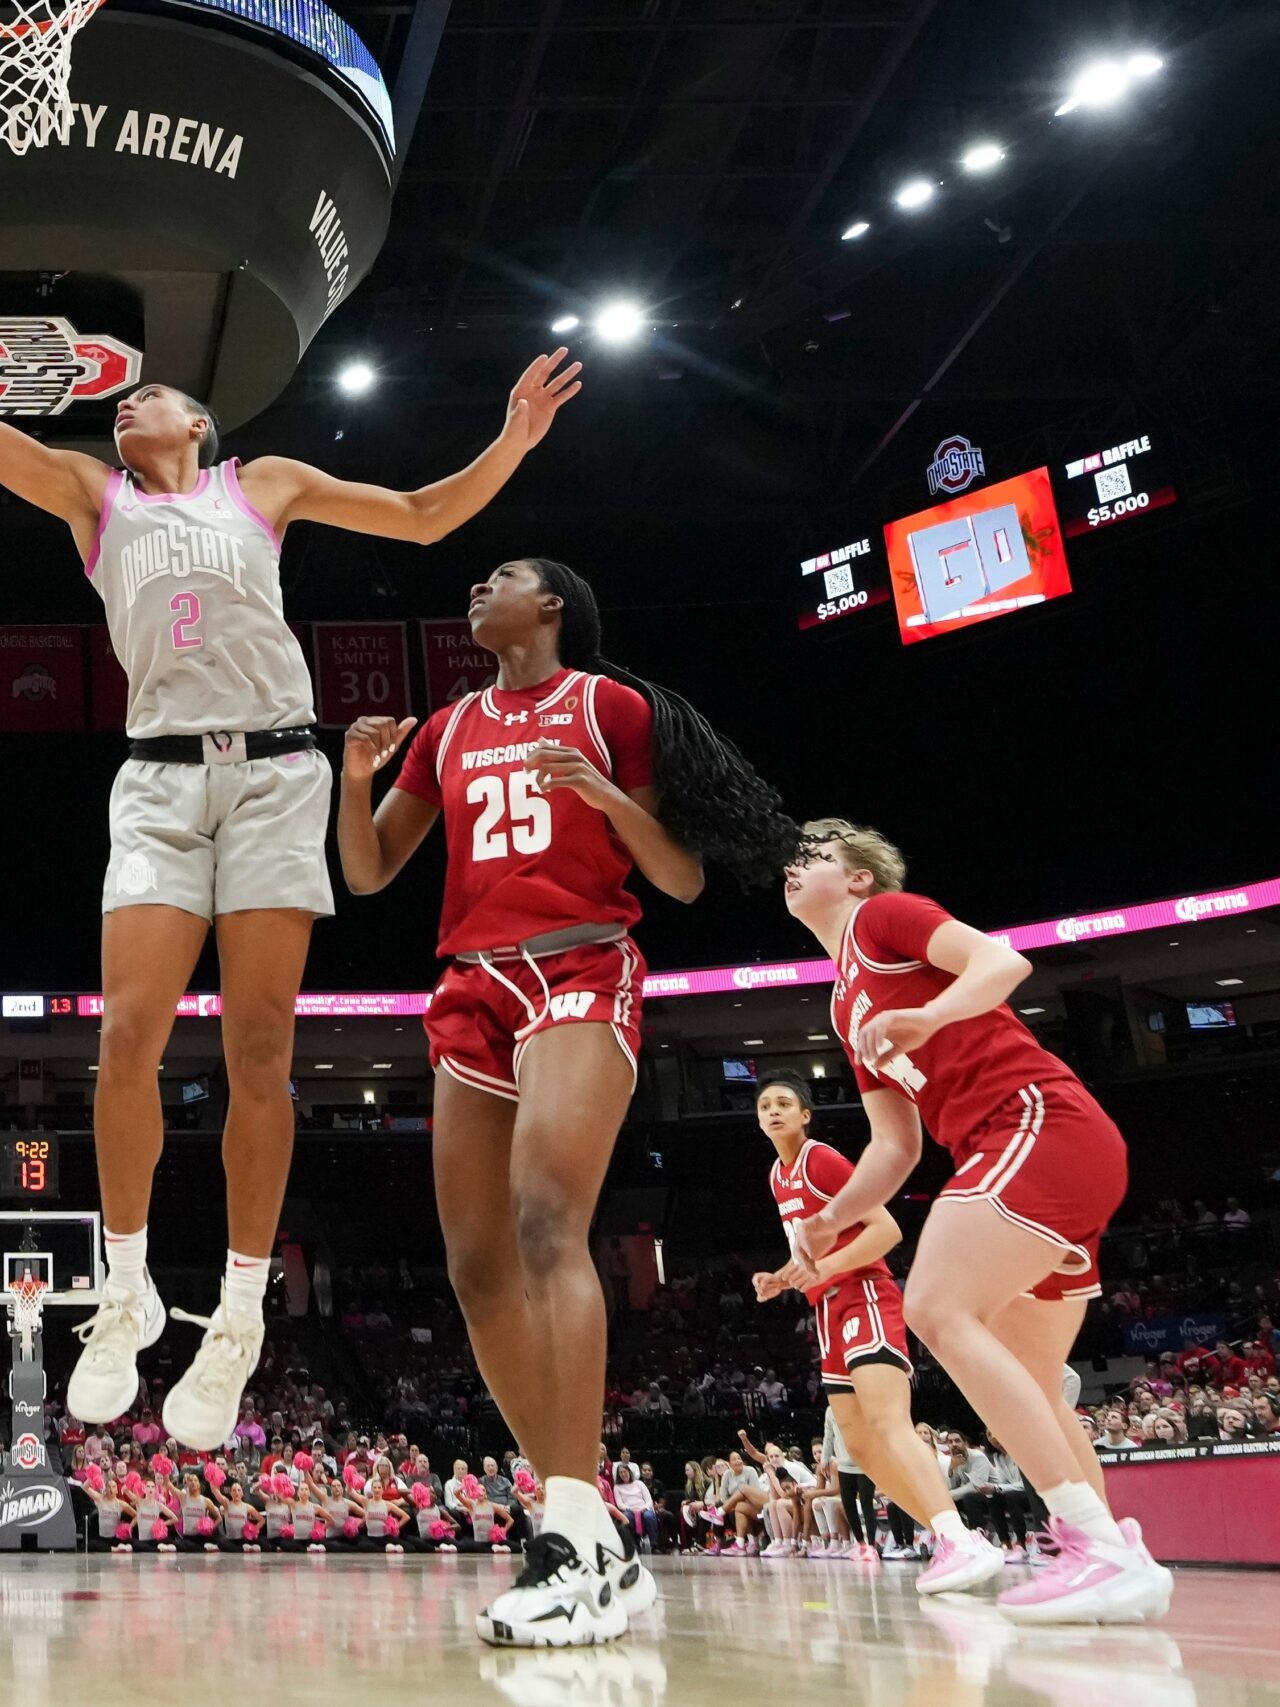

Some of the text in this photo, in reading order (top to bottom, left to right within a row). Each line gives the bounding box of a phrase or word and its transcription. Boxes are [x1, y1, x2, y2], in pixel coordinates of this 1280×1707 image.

[8, 102, 108, 150] CITY
[115, 109, 244, 179] ARENA
[309, 189, 349, 282] VALUE
[1101, 435, 1151, 466] RAFFLE
[1087, 492, 1149, 526] $5,000
[121, 519, 247, 609] OHIO STATE
[830, 538, 870, 565] RAFFLE
[908, 503, 1032, 623] GO
[170, 591, 203, 649] 2
[817, 591, 867, 620] $5,000
[332, 636, 389, 649] KATIE
[334, 652, 390, 665] SMITH
[448, 655, 493, 669] HALL
[340, 671, 390, 704] 30
[466, 769, 552, 862] 25
[1175, 892, 1249, 922] Corona
[1056, 914, 1126, 942] Corona
[643, 976, 689, 993] orona
[733, 967, 798, 989] Corona
[9, 1000, 37, 1012] 2nd
[50, 998, 71, 1014] 13
[549, 990, 596, 1021] W
[16, 1141, 49, 1159] 9:22
[22, 1160, 45, 1190] 13
[842, 1316, 860, 1345] W
[1130, 1322, 1167, 1348] Kroger
[1179, 1318, 1217, 1343] Kroger
[15, 1401, 41, 1417] Kroger
[1176, 1447, 1196, 1458] POWER
